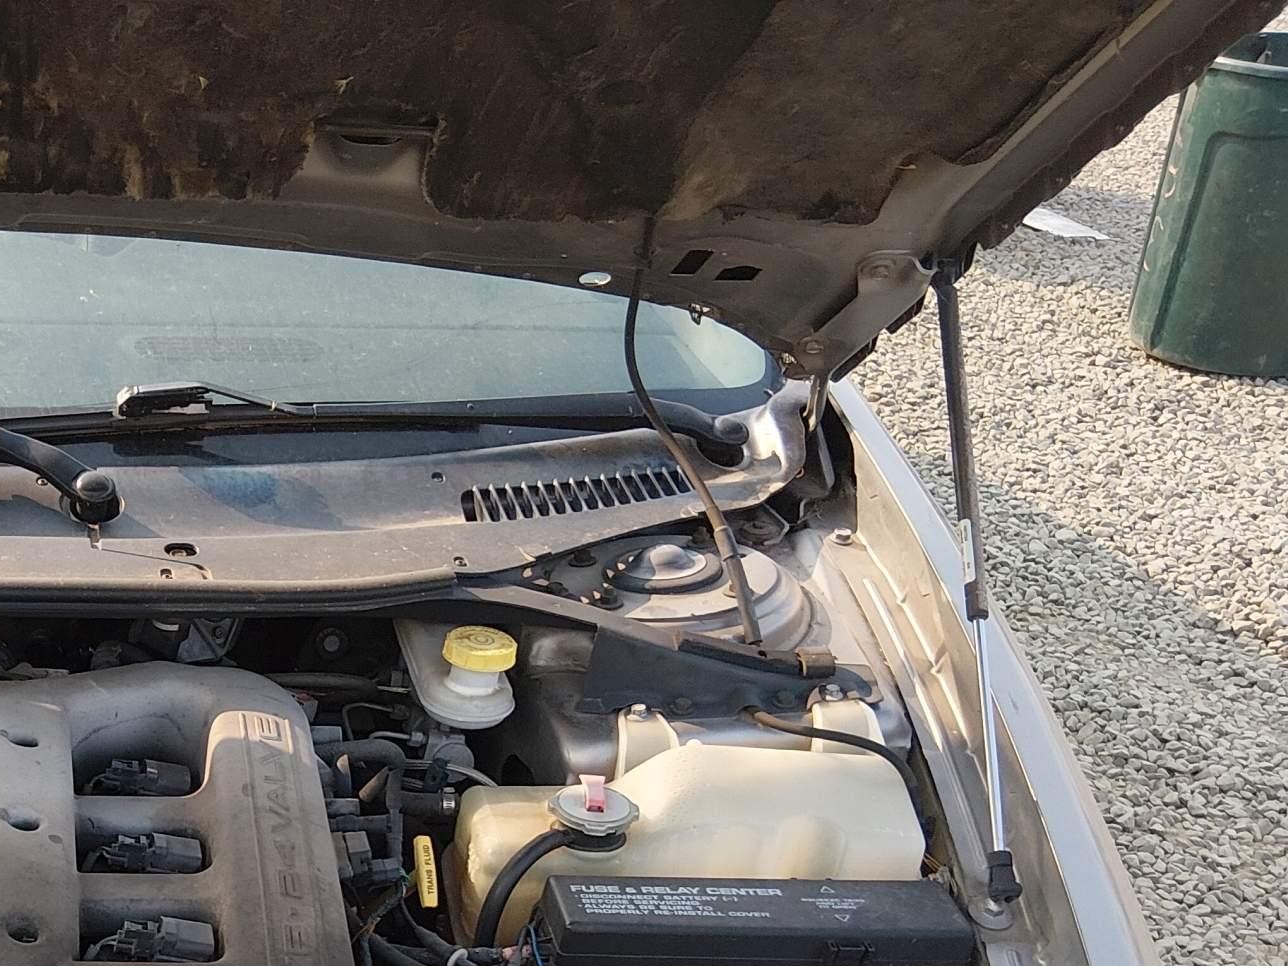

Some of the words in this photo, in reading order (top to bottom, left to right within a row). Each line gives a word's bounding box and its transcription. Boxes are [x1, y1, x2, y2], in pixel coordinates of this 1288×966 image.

[423, 844, 432, 866] FLUID
[569, 885, 620, 893] FUSE
[640, 886, 700, 894] RELAY
[705, 887, 783, 896] CENTER
